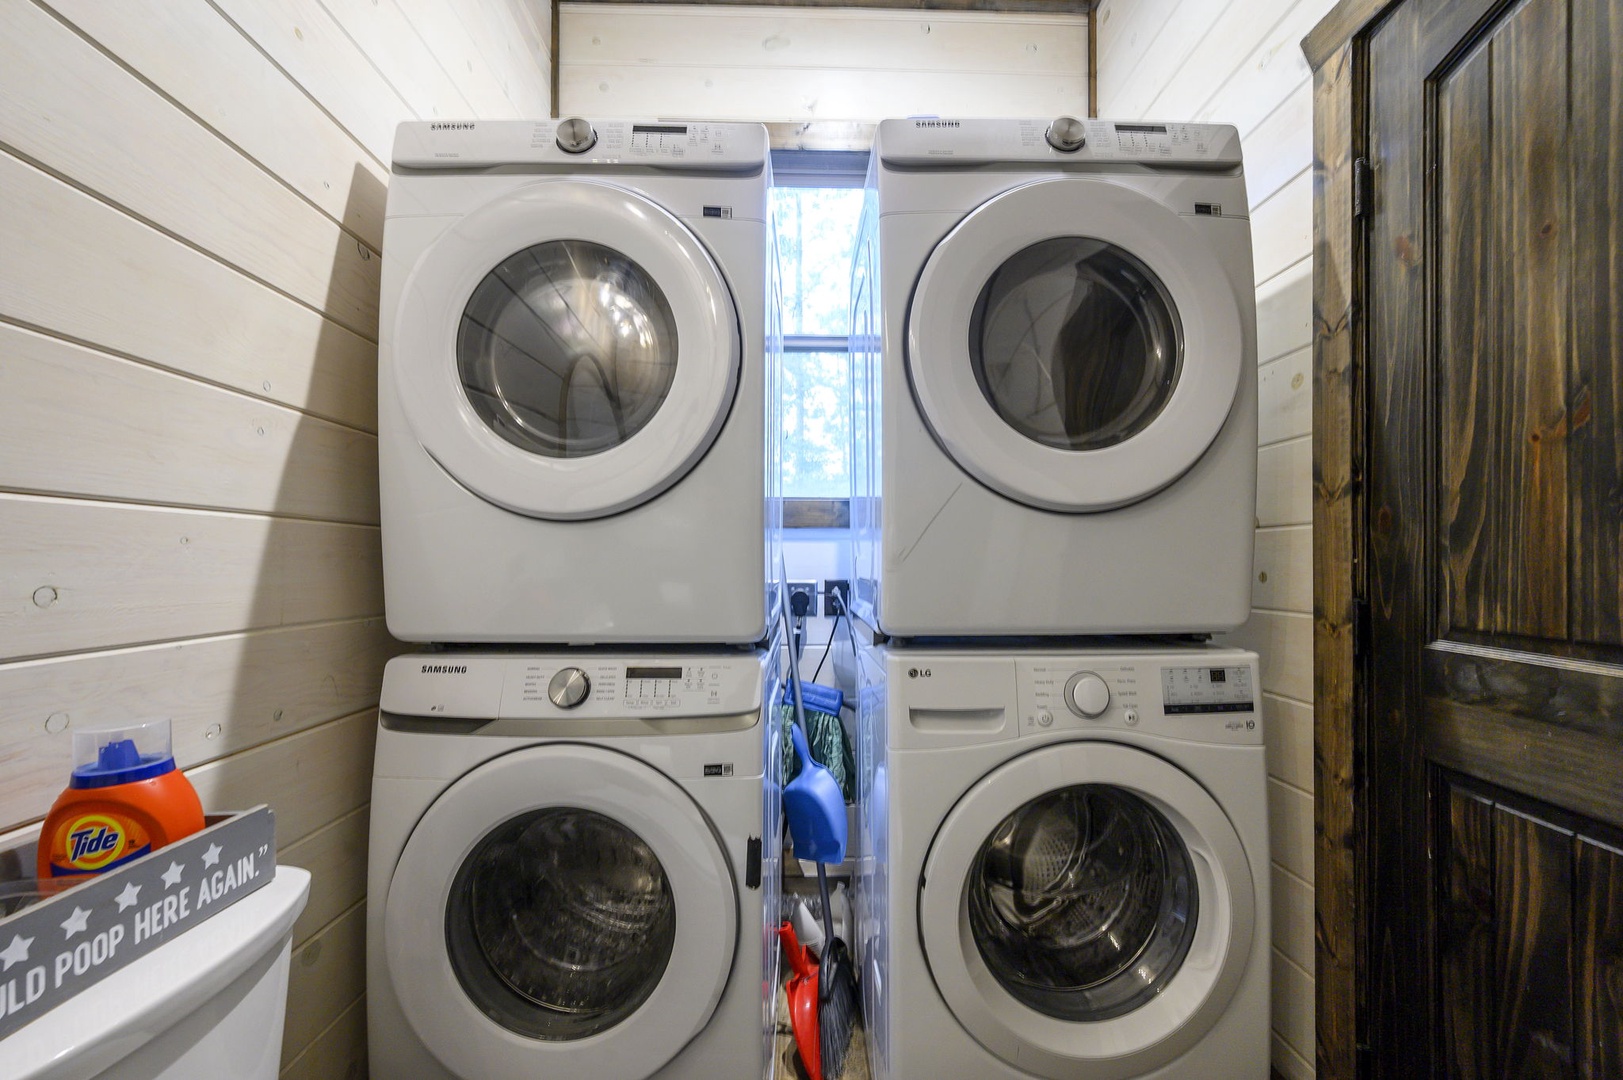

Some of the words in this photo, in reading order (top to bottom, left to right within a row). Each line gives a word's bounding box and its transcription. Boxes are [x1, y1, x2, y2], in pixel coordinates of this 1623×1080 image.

[430, 123, 475, 131] SAMSUNG
[915, 120, 960, 128] SAMSUNG
[421, 665, 467, 674] SAMSUNG
[70, 826, 120, 863] Tide
[55, 923, 125, 989] POOP
[134, 886, 190, 945] HERE
